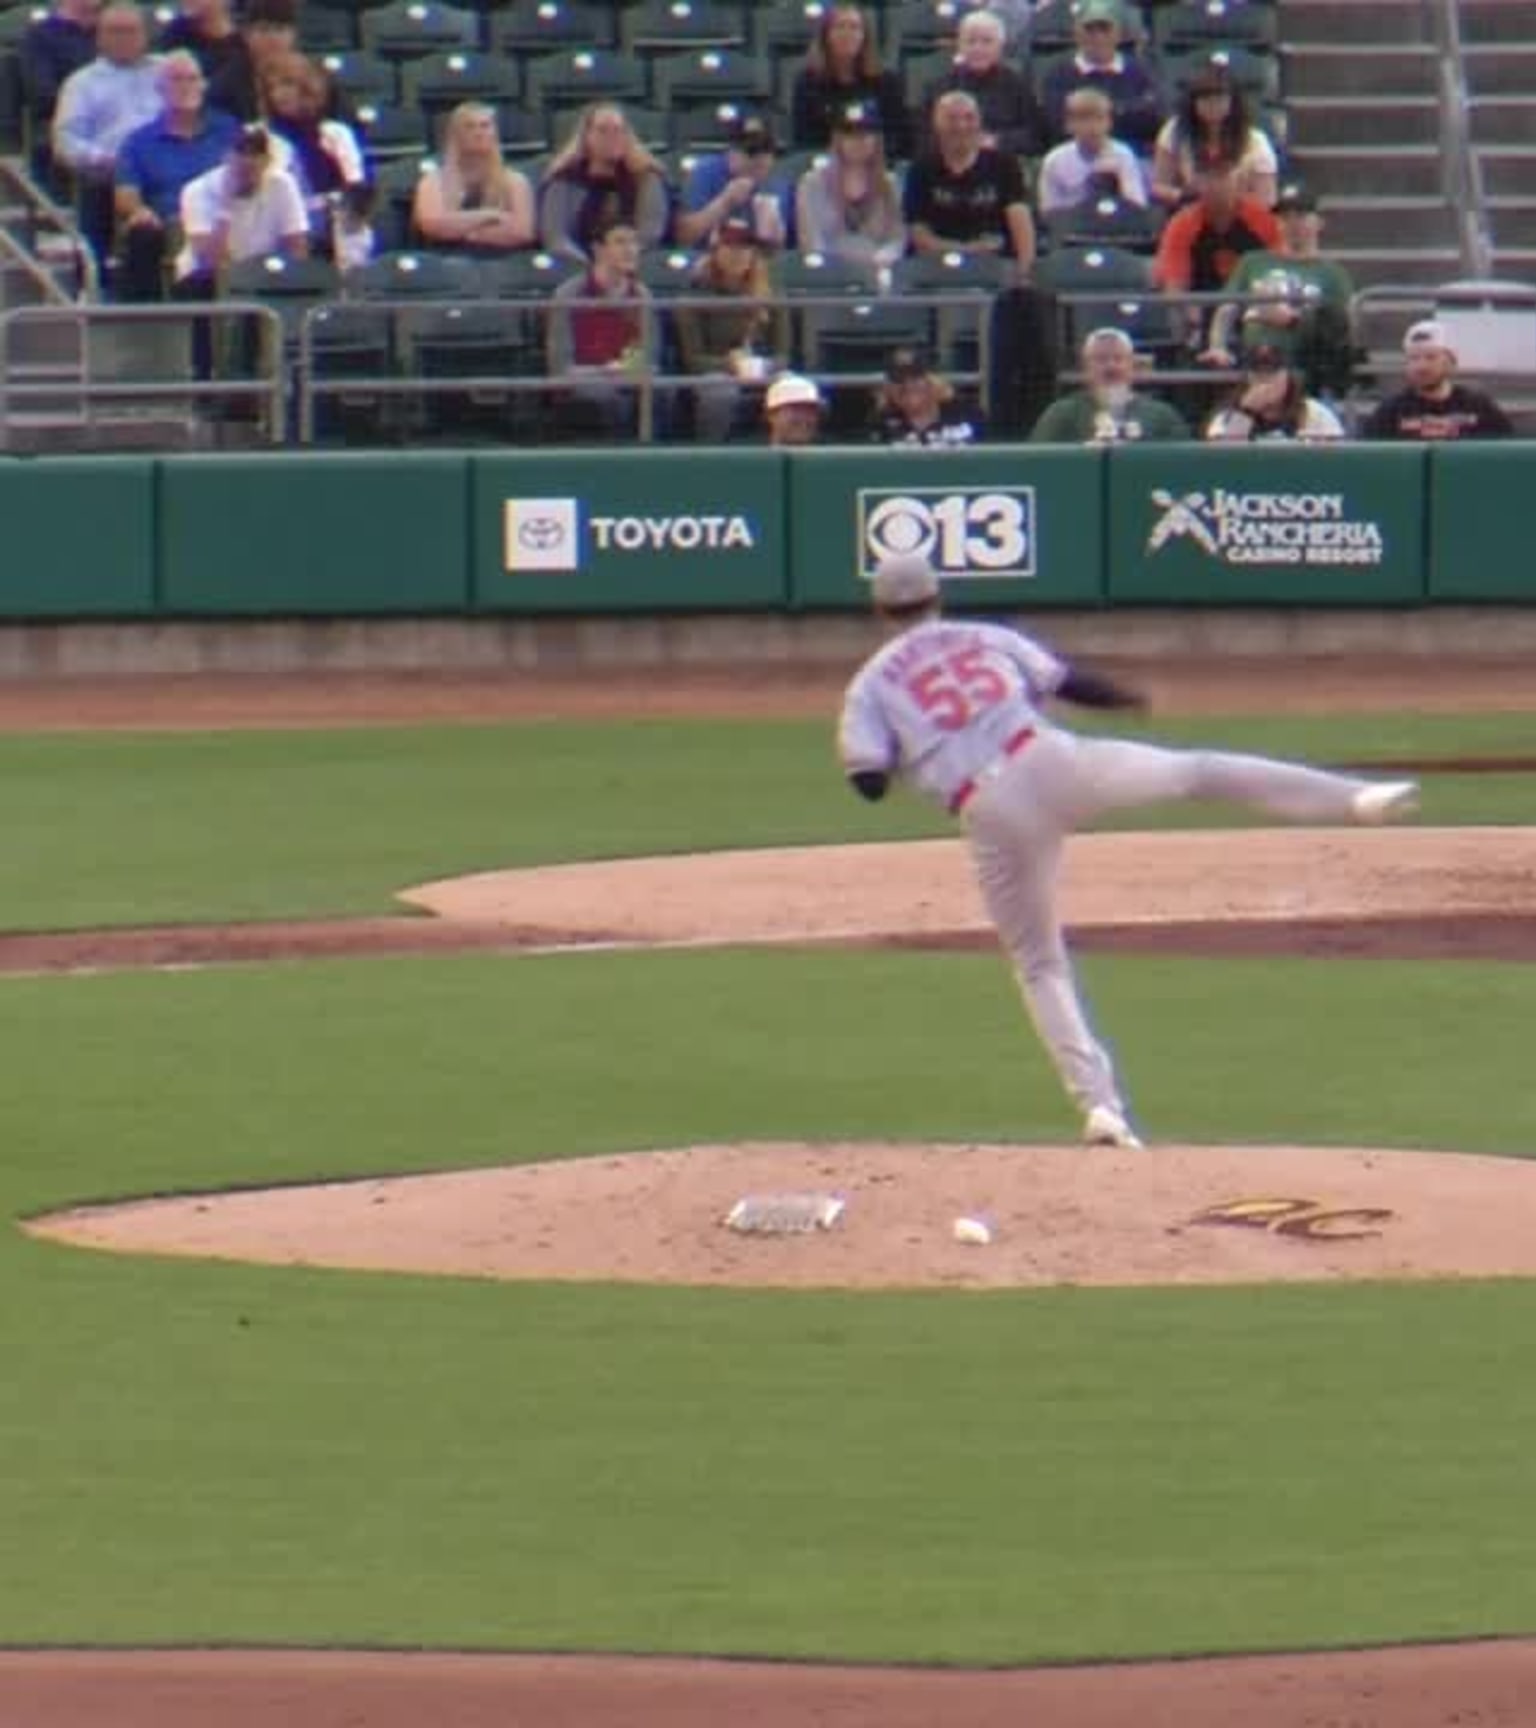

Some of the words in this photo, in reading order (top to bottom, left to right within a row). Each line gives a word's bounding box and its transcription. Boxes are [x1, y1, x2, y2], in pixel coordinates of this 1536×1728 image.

[591, 517, 752, 549] TOYOTA
[931, 495, 1026, 567] 13
[907, 652, 1010, 733] 55
